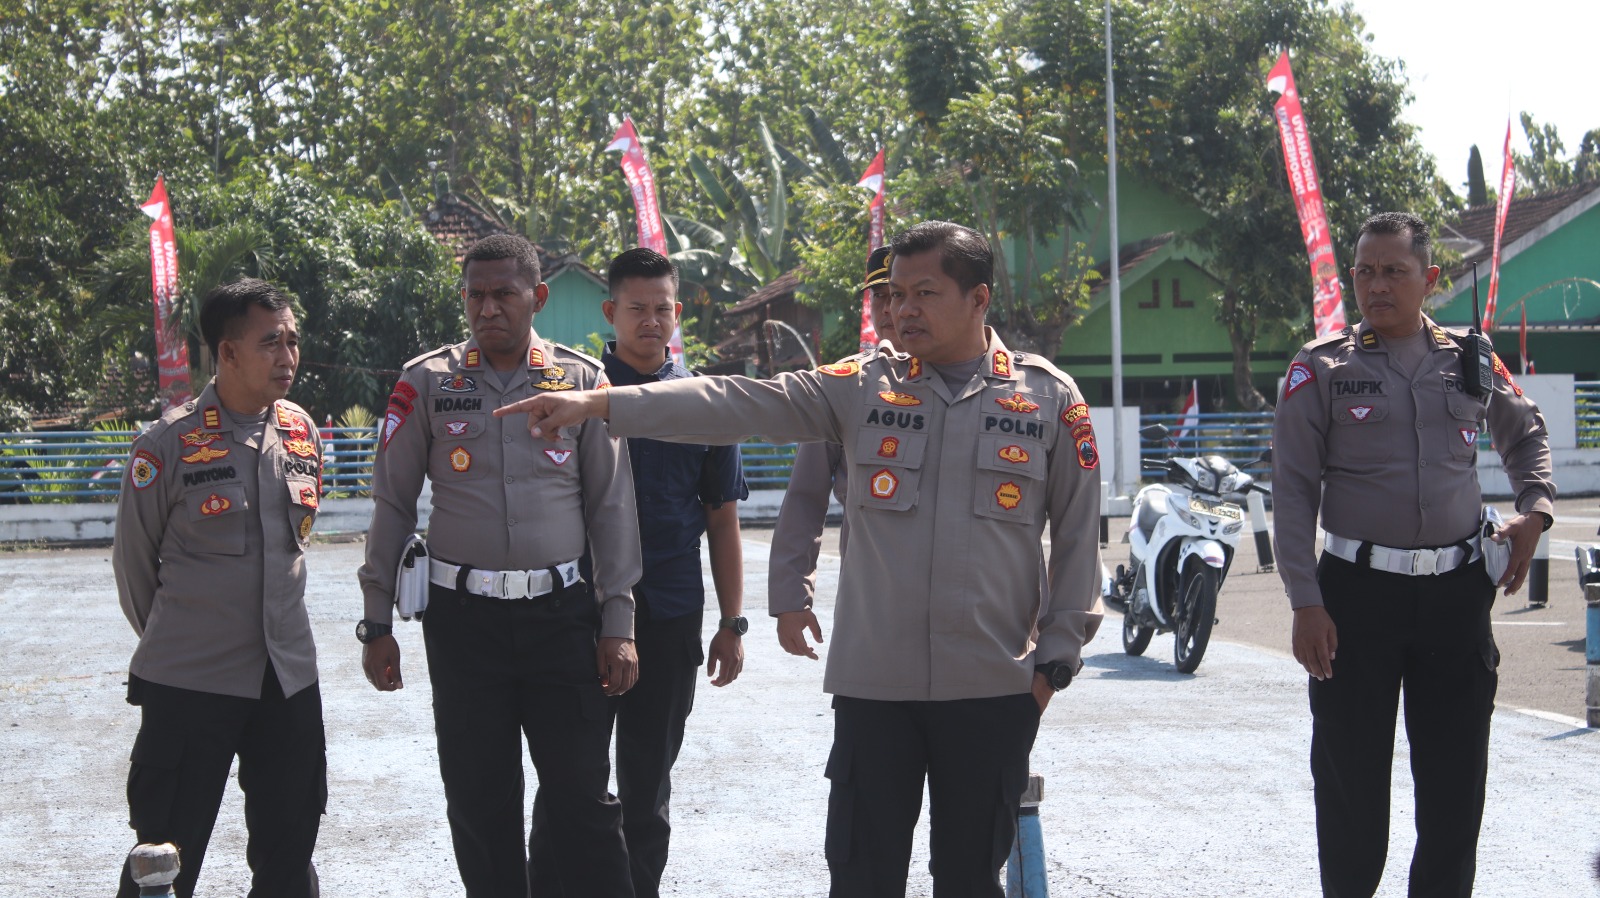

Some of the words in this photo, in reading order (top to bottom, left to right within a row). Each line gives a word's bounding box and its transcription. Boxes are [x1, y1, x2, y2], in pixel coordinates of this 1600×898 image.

[1334, 380, 1383, 395] TAUFIK
[866, 408, 925, 430] AGUS
[985, 416, 1044, 440] POLRI
